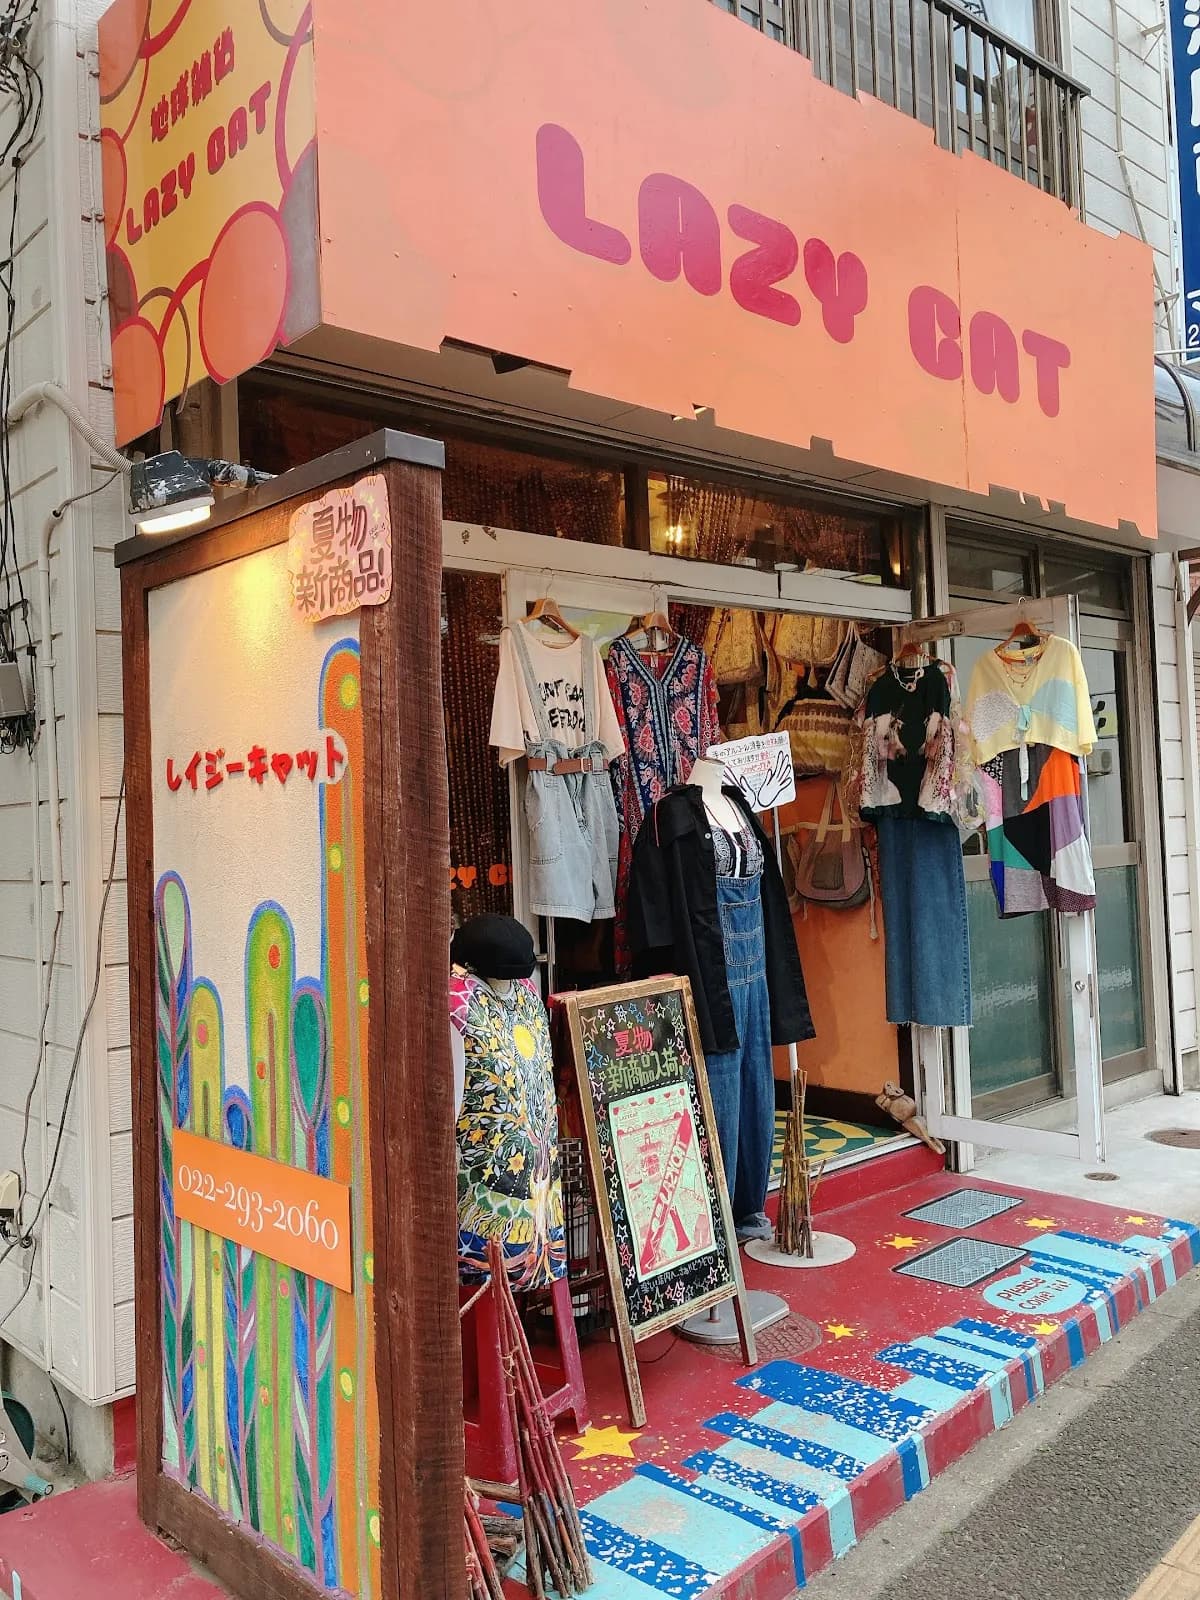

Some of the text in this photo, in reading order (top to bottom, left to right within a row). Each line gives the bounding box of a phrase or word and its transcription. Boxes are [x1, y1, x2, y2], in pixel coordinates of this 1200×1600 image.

[126, 80, 272, 245] LAZY CAT
[536, 122, 1071, 417] LAZY CAT
[310, 499, 368, 565] 夏物
[166, 735, 344, 792] レイジーキャット
[613, 1025, 654, 1057] 夏物
[178, 1164, 339, 1250] 022-293-2060
